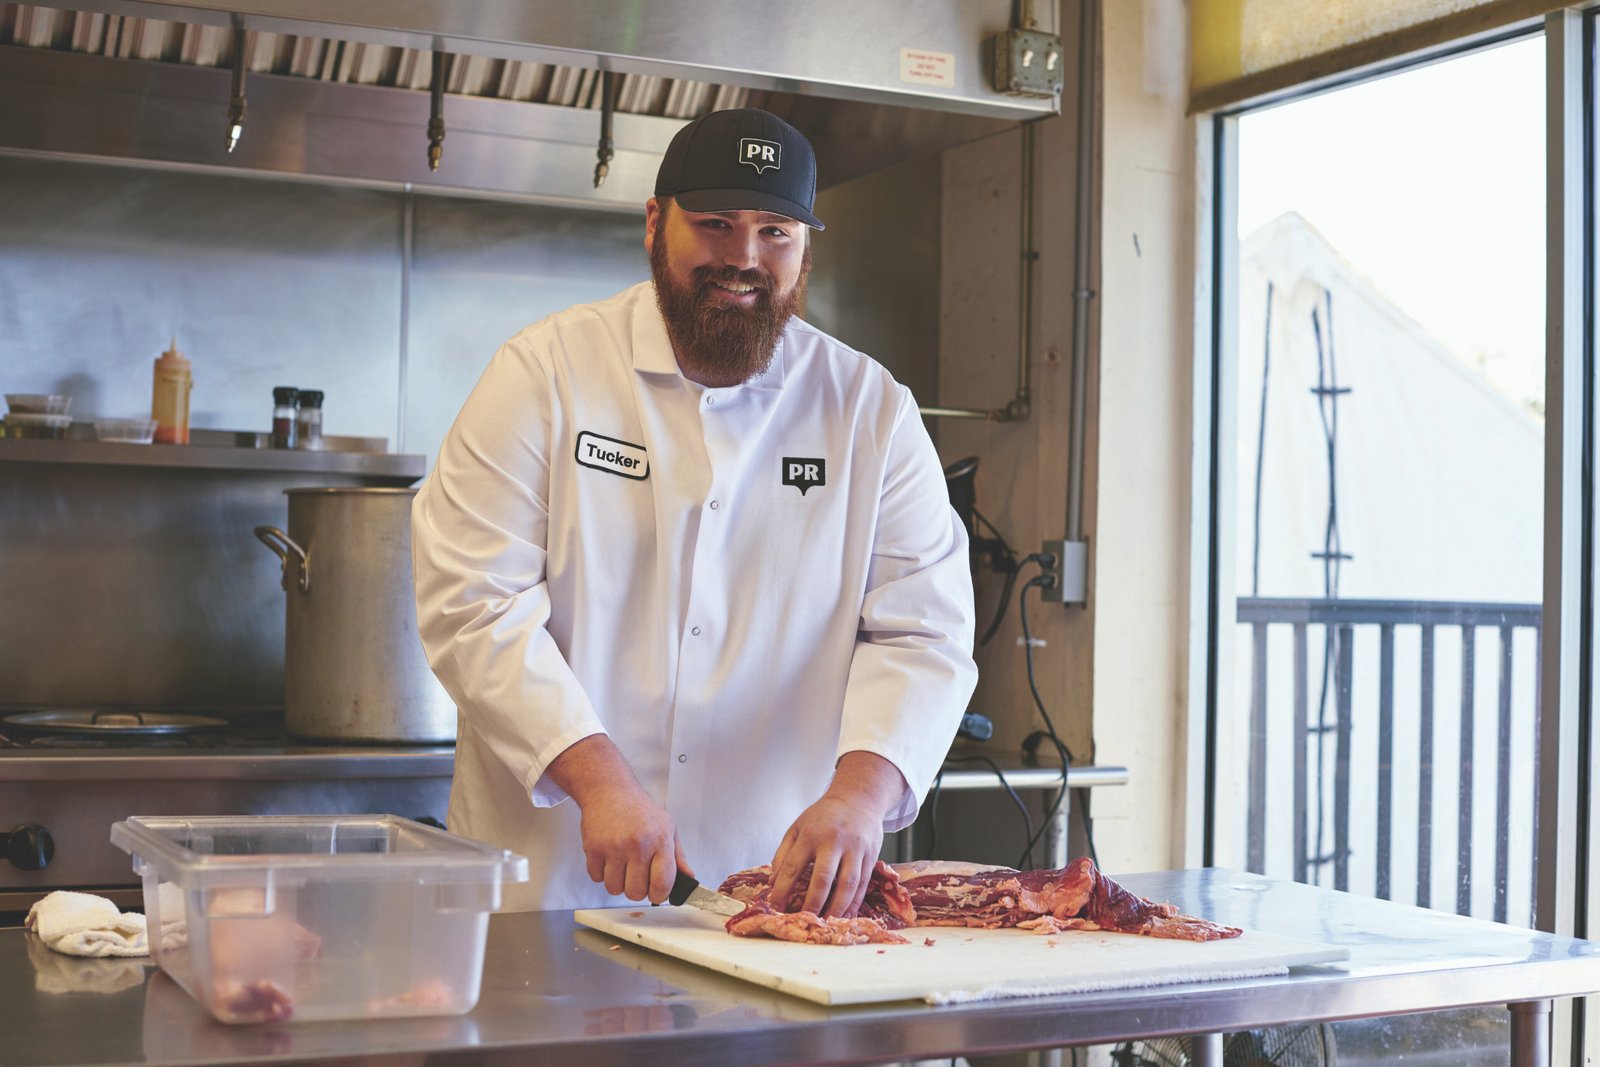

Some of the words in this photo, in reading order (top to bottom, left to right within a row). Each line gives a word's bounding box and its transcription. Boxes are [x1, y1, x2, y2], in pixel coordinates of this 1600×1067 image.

[747, 143, 775, 162] PR
[586, 442, 641, 470] Tucker
[789, 463, 819, 481] PR
